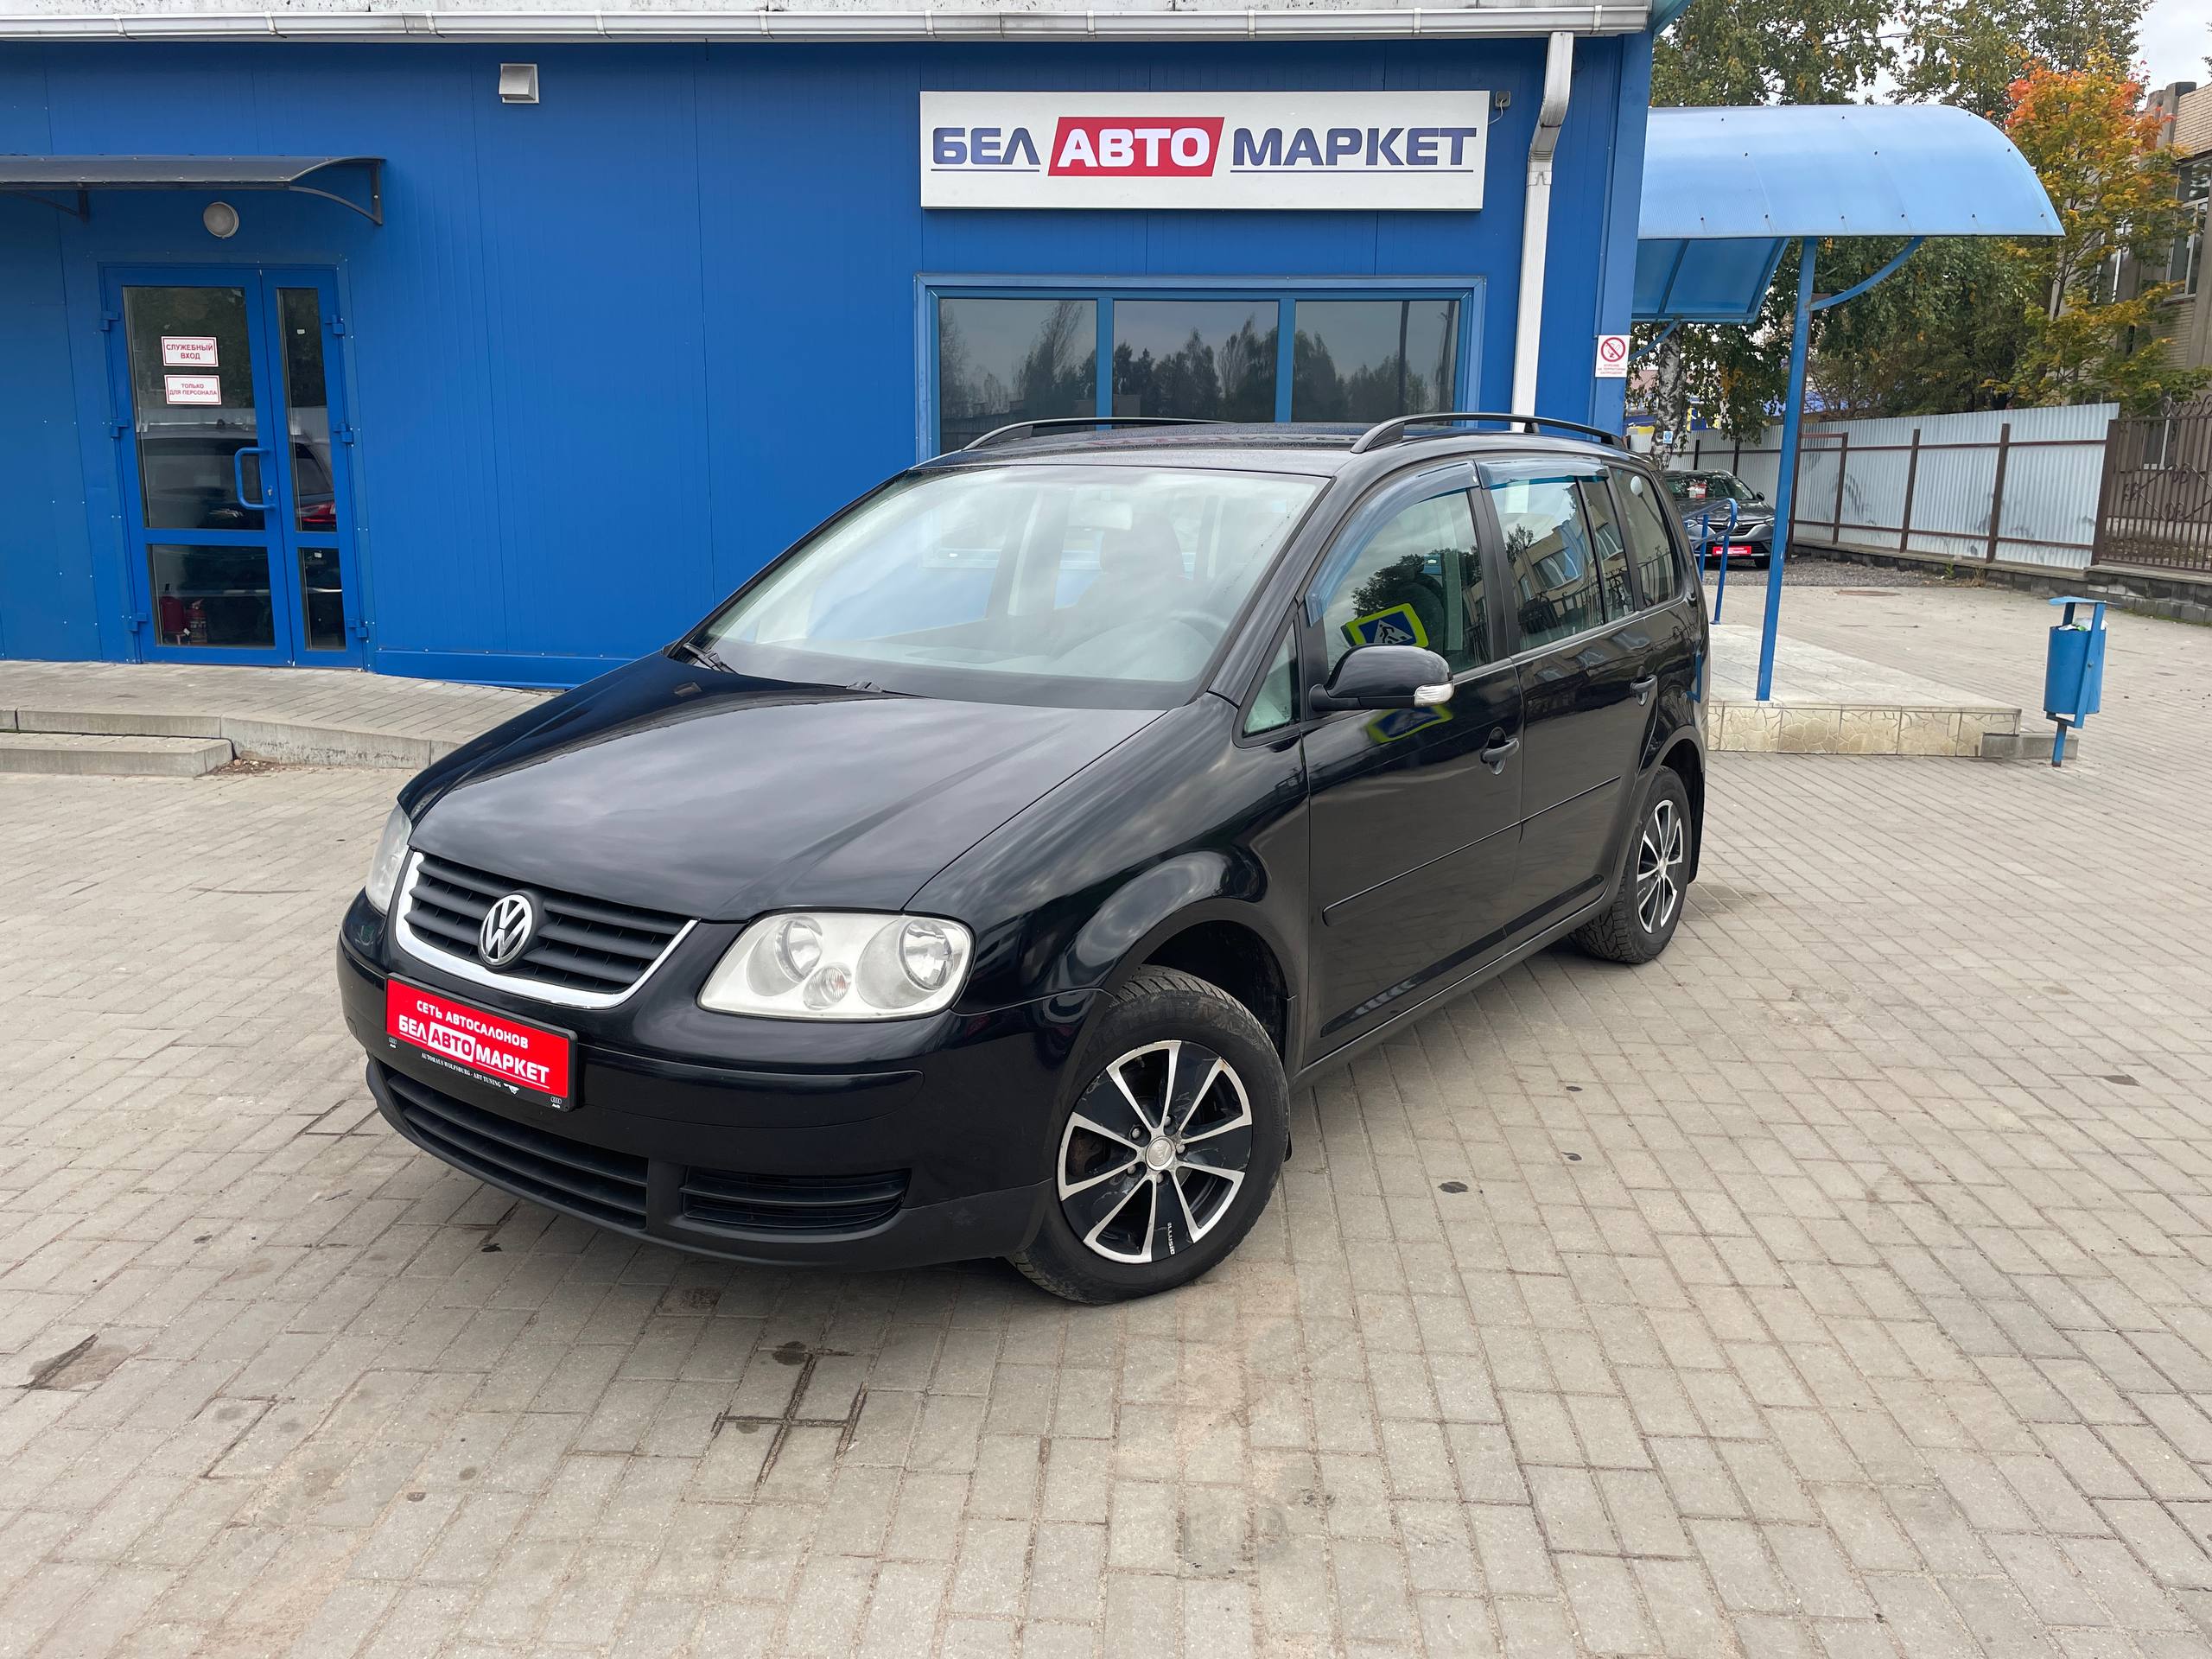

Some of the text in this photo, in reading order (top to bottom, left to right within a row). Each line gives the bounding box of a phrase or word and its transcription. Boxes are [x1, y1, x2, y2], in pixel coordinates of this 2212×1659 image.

[1231, 127, 1478, 167] МАРКЕТ
[416, 1000, 529, 1049] СЕТЬ АВТОСАЛОНОВ
